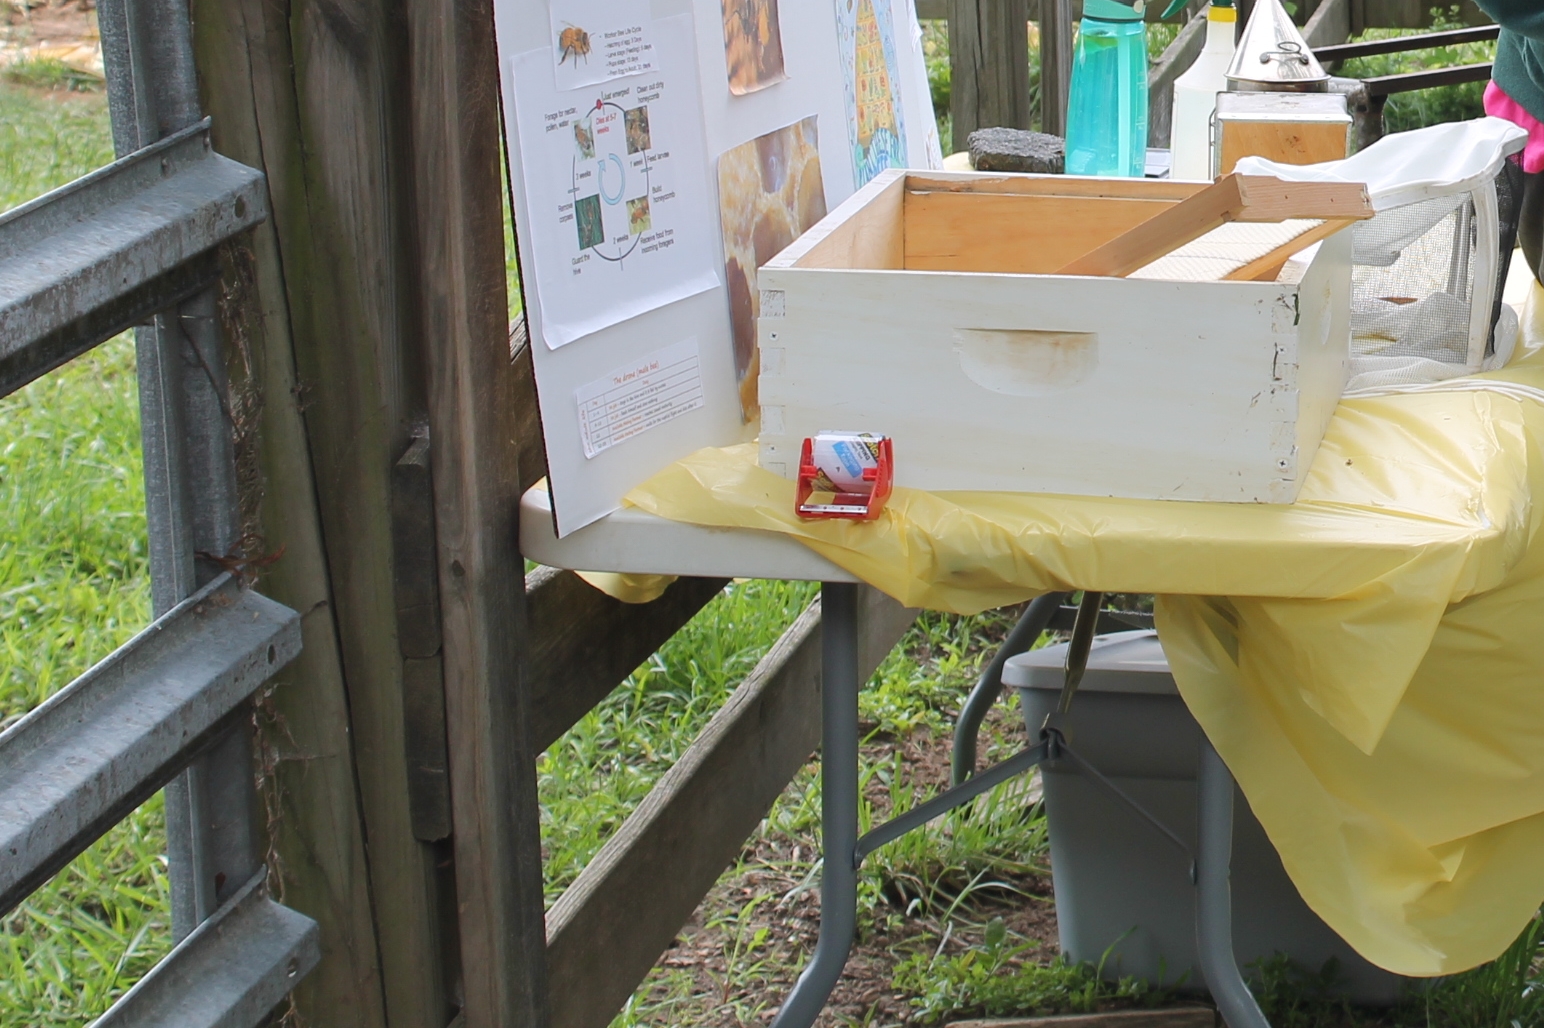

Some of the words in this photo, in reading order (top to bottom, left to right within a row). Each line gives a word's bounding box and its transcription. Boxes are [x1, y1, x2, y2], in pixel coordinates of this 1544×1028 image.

[632, 26, 642, 34] Cycle
[637, 86, 648, 94] Clean
[638, 92, 660, 104] honeycomb
[544, 111, 558, 121] Forage
[596, 116, 606, 124] Dies
[558, 120, 570, 128] water
[597, 126, 610, 134] weeks
[647, 154, 657, 162] Feed
[657, 152, 670, 160] larvae
[633, 158, 644, 168] week
[580, 170, 592, 178] weeks
[652, 186, 662, 194] Build
[653, 192, 676, 203] honeycomb
[558, 202, 574, 212] Remove
[616, 234, 629, 242] weeks
[640, 234, 656, 244] Receive
[656, 232, 664, 240] food
[664, 228, 674, 236] from
[642, 242, 658, 254] incoming
[572, 256, 584, 266] Guard
[573, 268, 582, 276] hive
[613, 376, 622, 385] The
[622, 371, 636, 382] drone
[636, 364, 649, 378] (male
[650, 360, 660, 371] bee)
